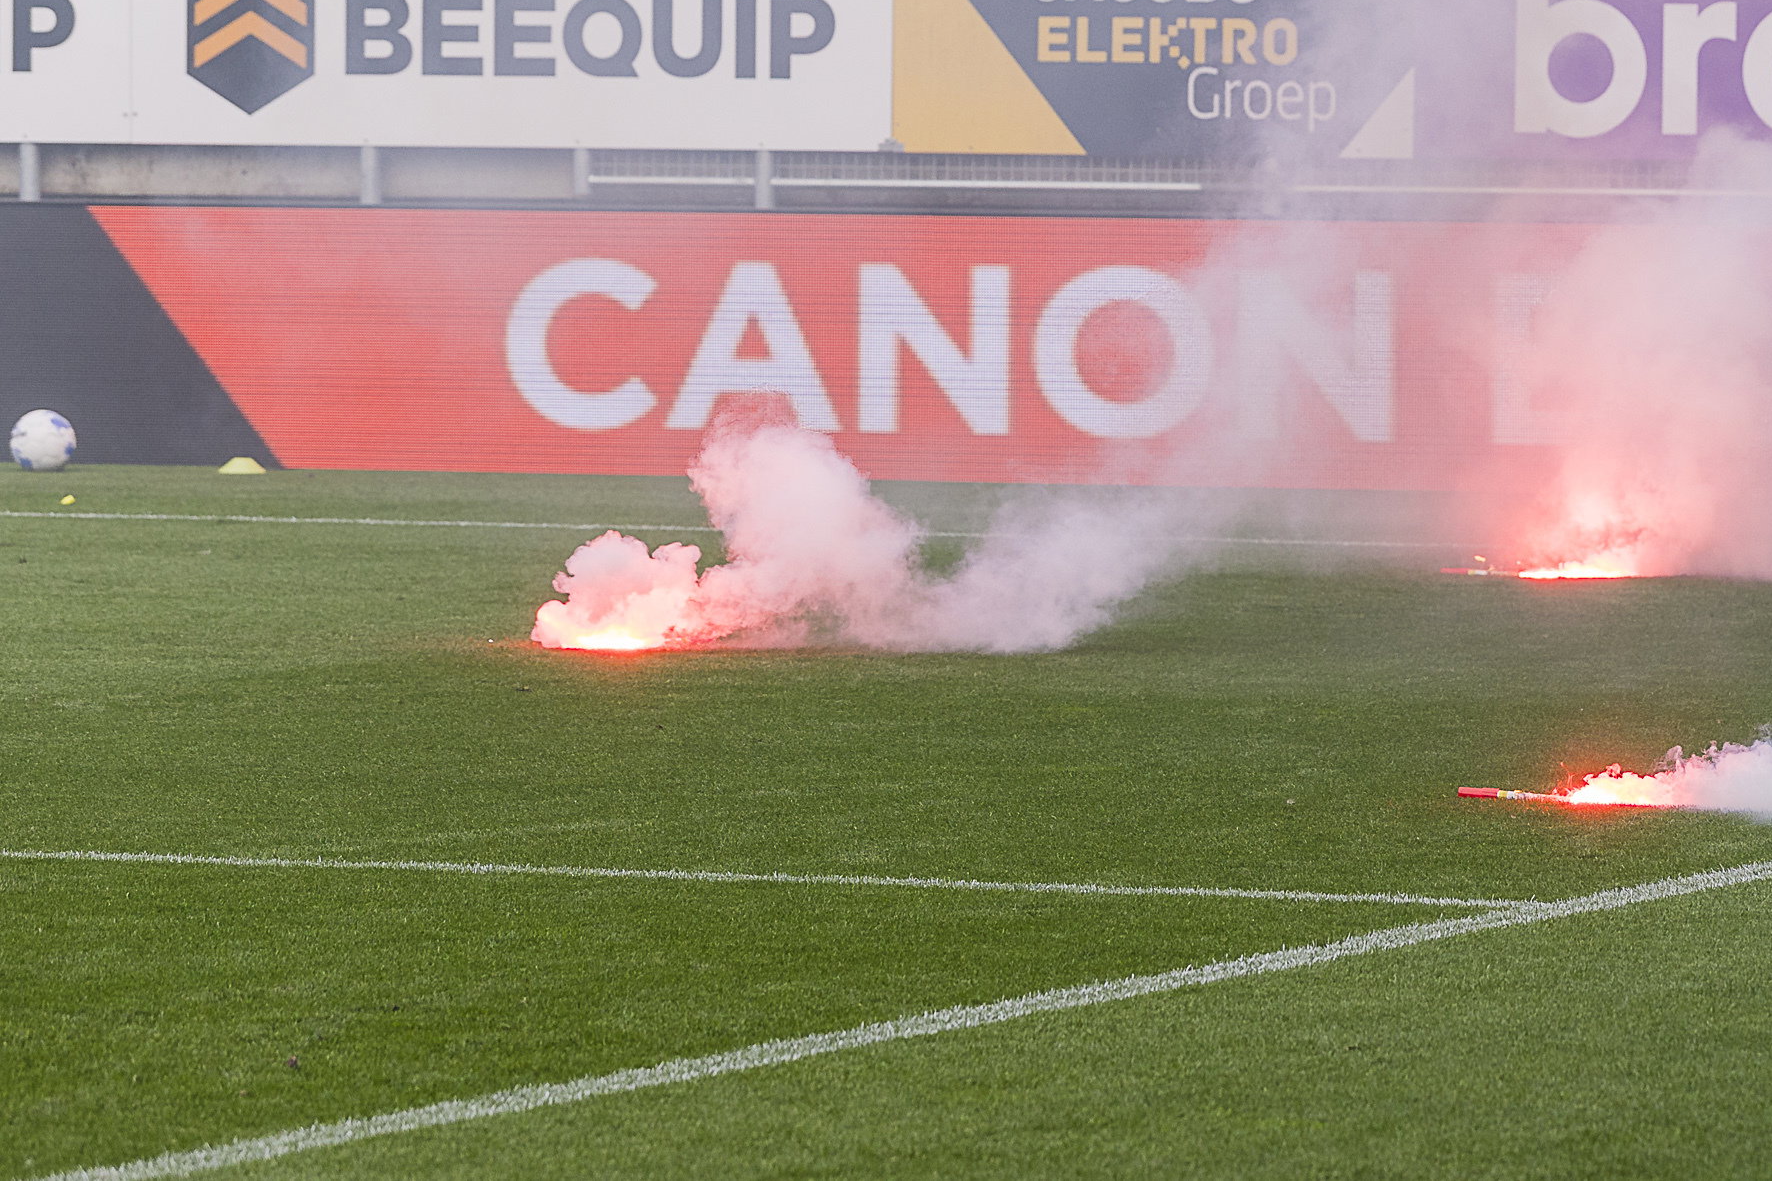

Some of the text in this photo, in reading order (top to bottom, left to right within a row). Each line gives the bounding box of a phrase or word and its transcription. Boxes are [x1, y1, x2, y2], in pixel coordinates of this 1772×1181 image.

[1036, 16, 1299, 70] ELEKTRO
[1187, 65, 1338, 132] Groep
[504, 256, 1393, 445] CANON
